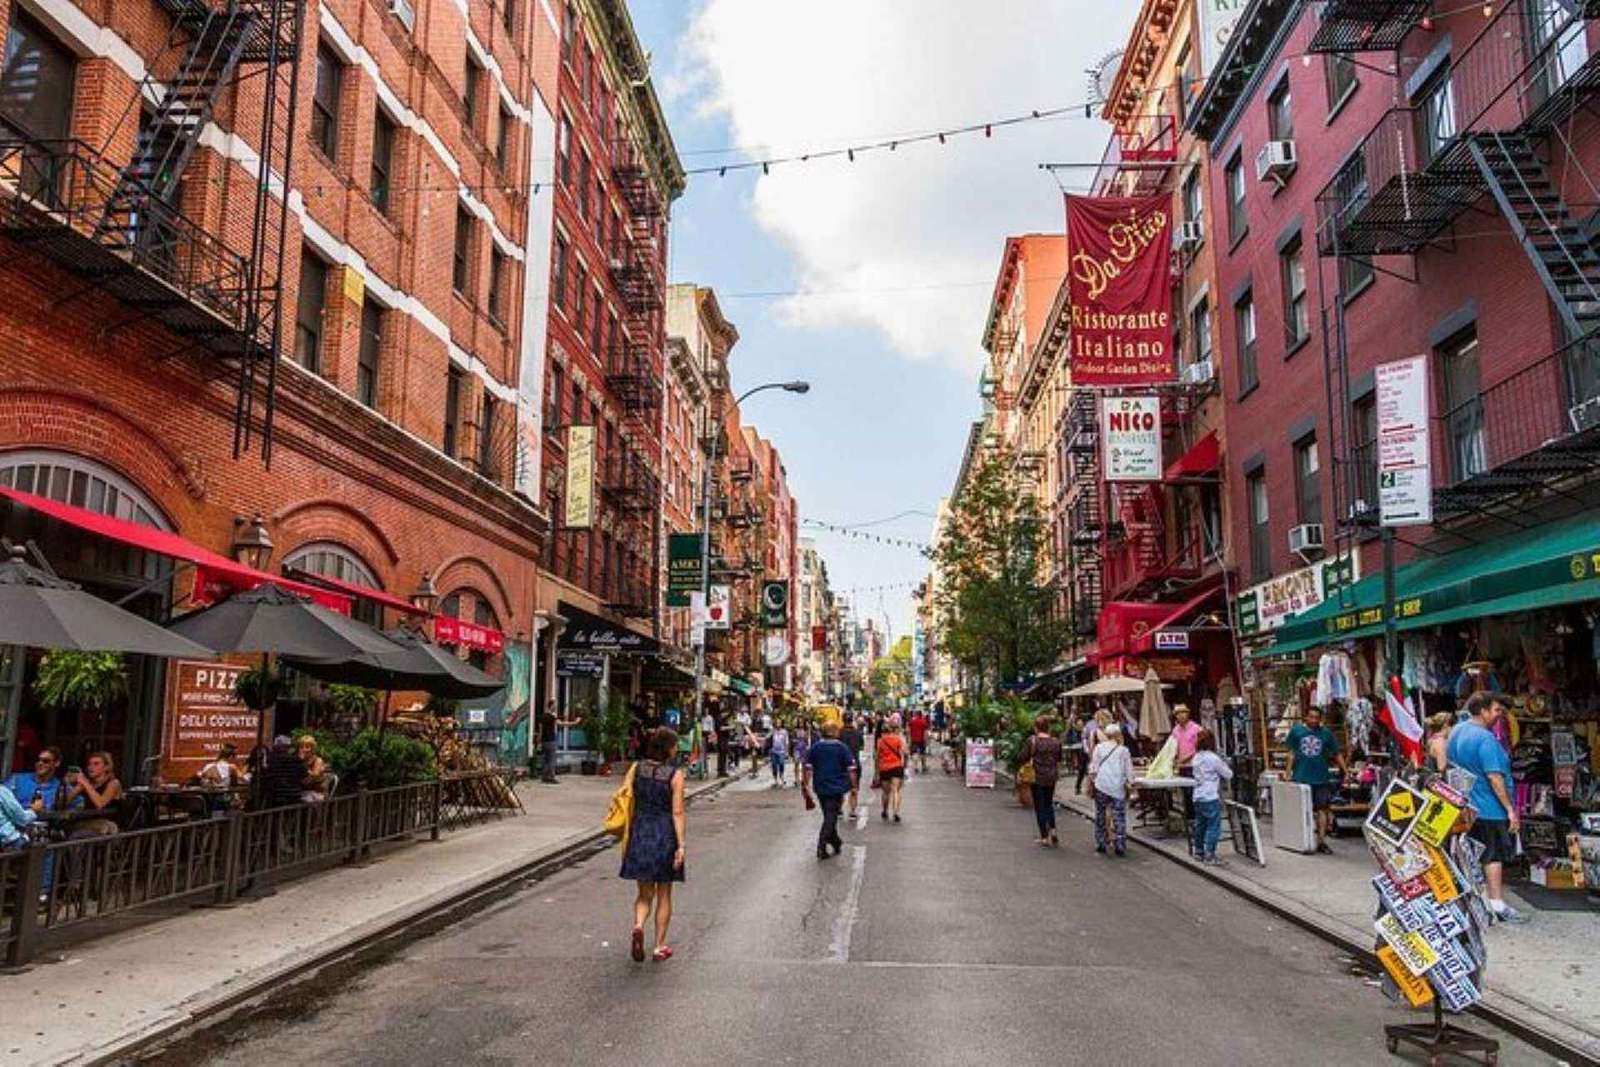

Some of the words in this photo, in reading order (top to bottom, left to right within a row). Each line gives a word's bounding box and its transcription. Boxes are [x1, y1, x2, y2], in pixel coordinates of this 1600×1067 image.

[1072, 248, 1120, 300] Da
[1072, 305, 1168, 329] Ristorante
[1076, 335, 1163, 358] Italiano
[1121, 401, 1142, 410] DA
[1110, 412, 1153, 431] NICO
[1158, 632, 1186, 642] ATM
[196, 669, 238, 689] PIZZ
[180, 714, 206, 727] DELI
[208, 714, 258, 728] COUNTER
